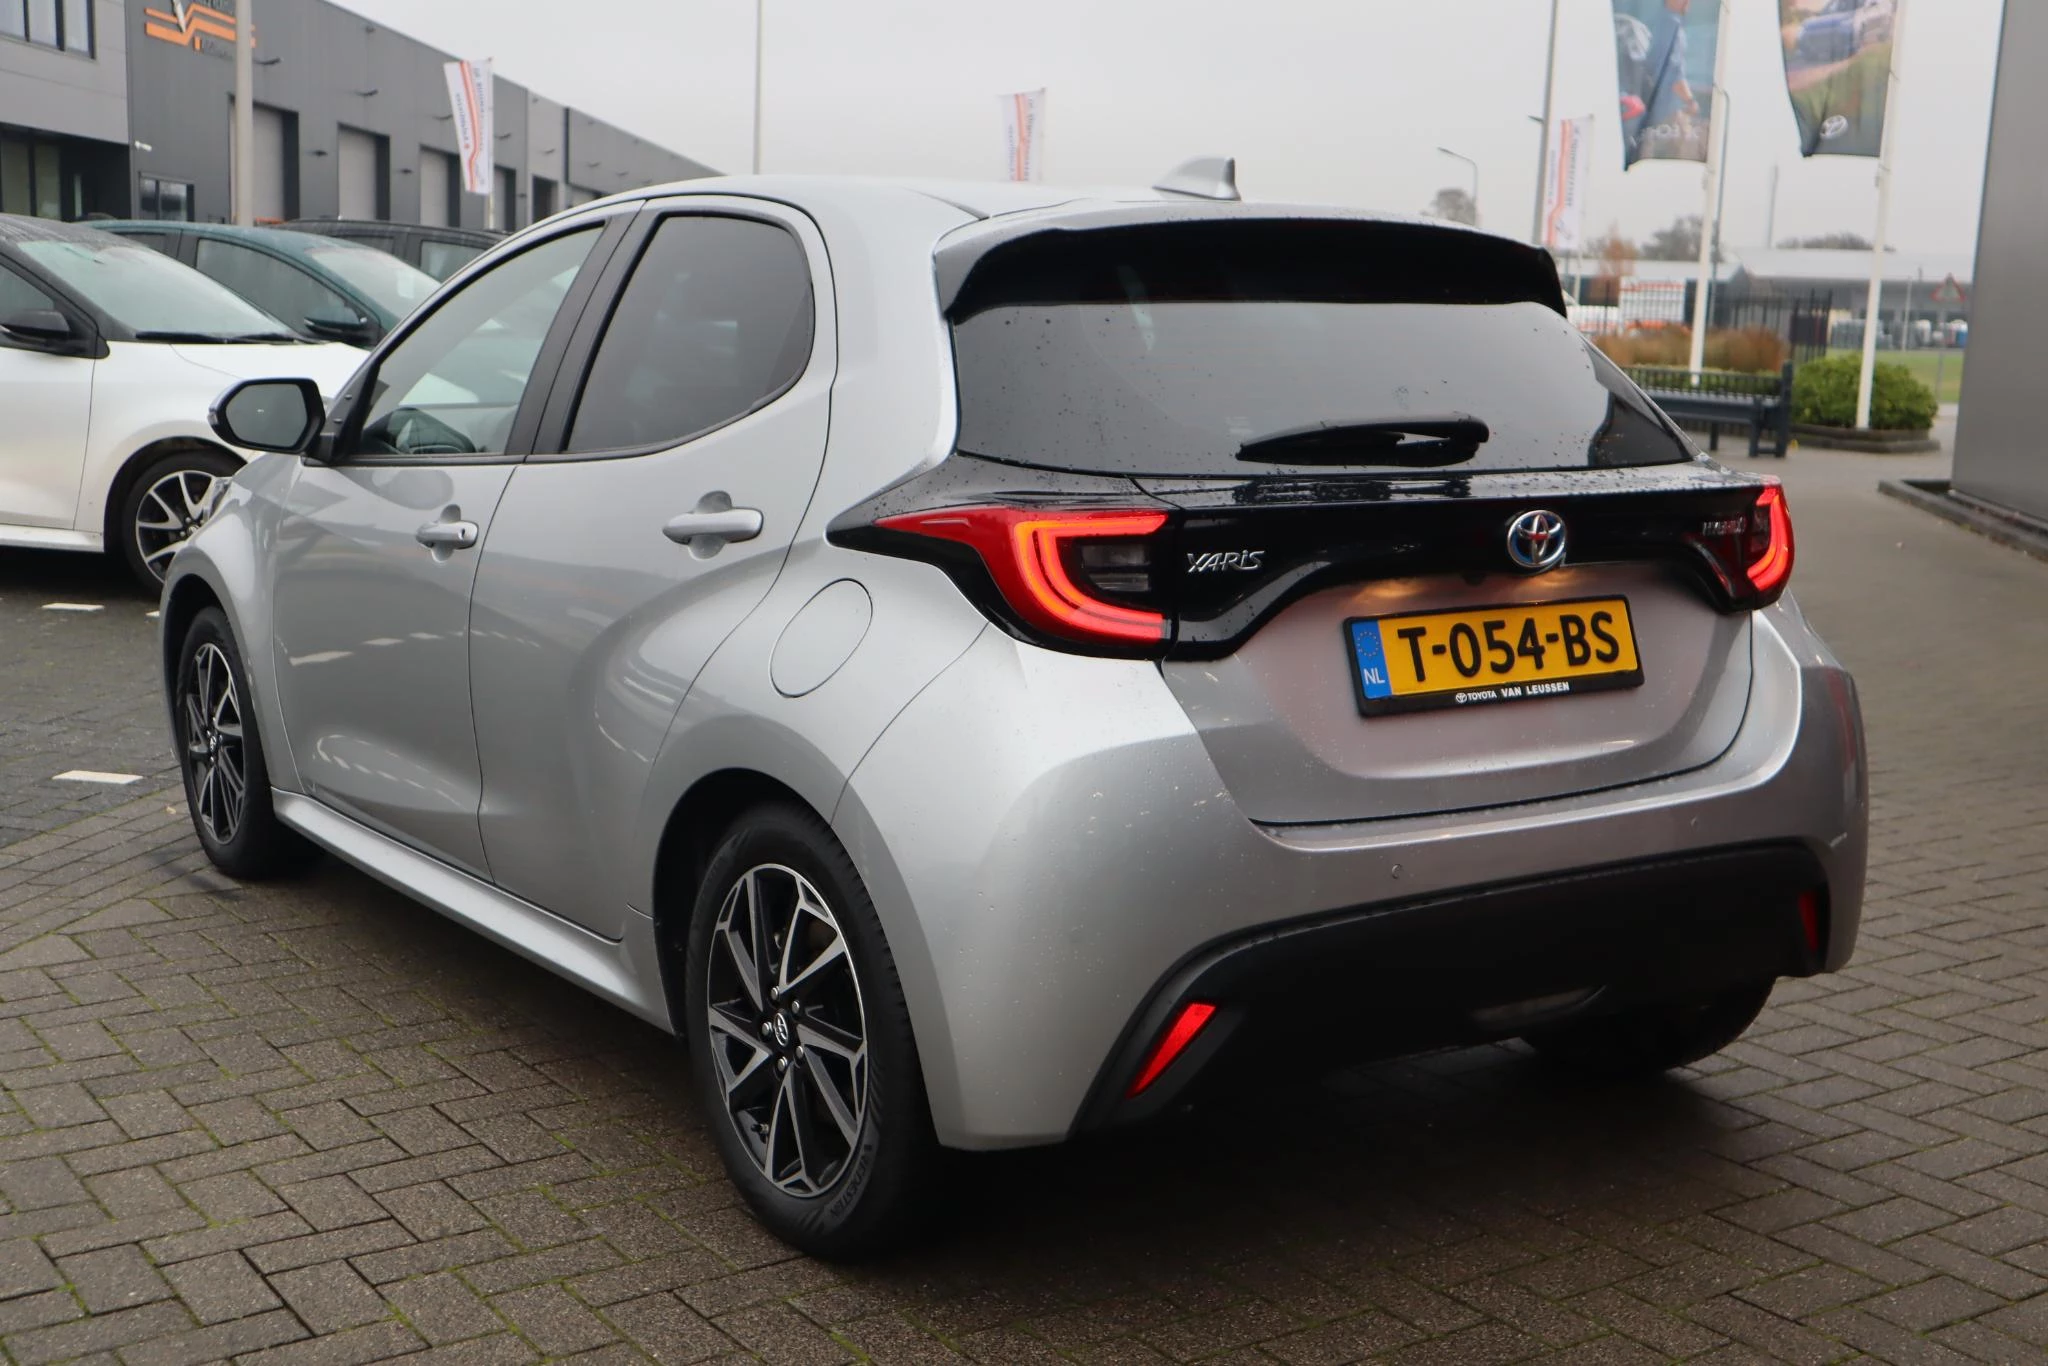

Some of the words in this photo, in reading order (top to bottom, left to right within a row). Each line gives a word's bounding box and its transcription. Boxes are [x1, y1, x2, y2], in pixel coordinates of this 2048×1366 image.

[1397, 611, 1620, 683] T-054-BS
[1363, 667, 1386, 685] NL
[1467, 690, 1498, 701] TOYOTA
[1501, 686, 1522, 698] VAN
[1526, 681, 1570, 695] LEUSSEN
